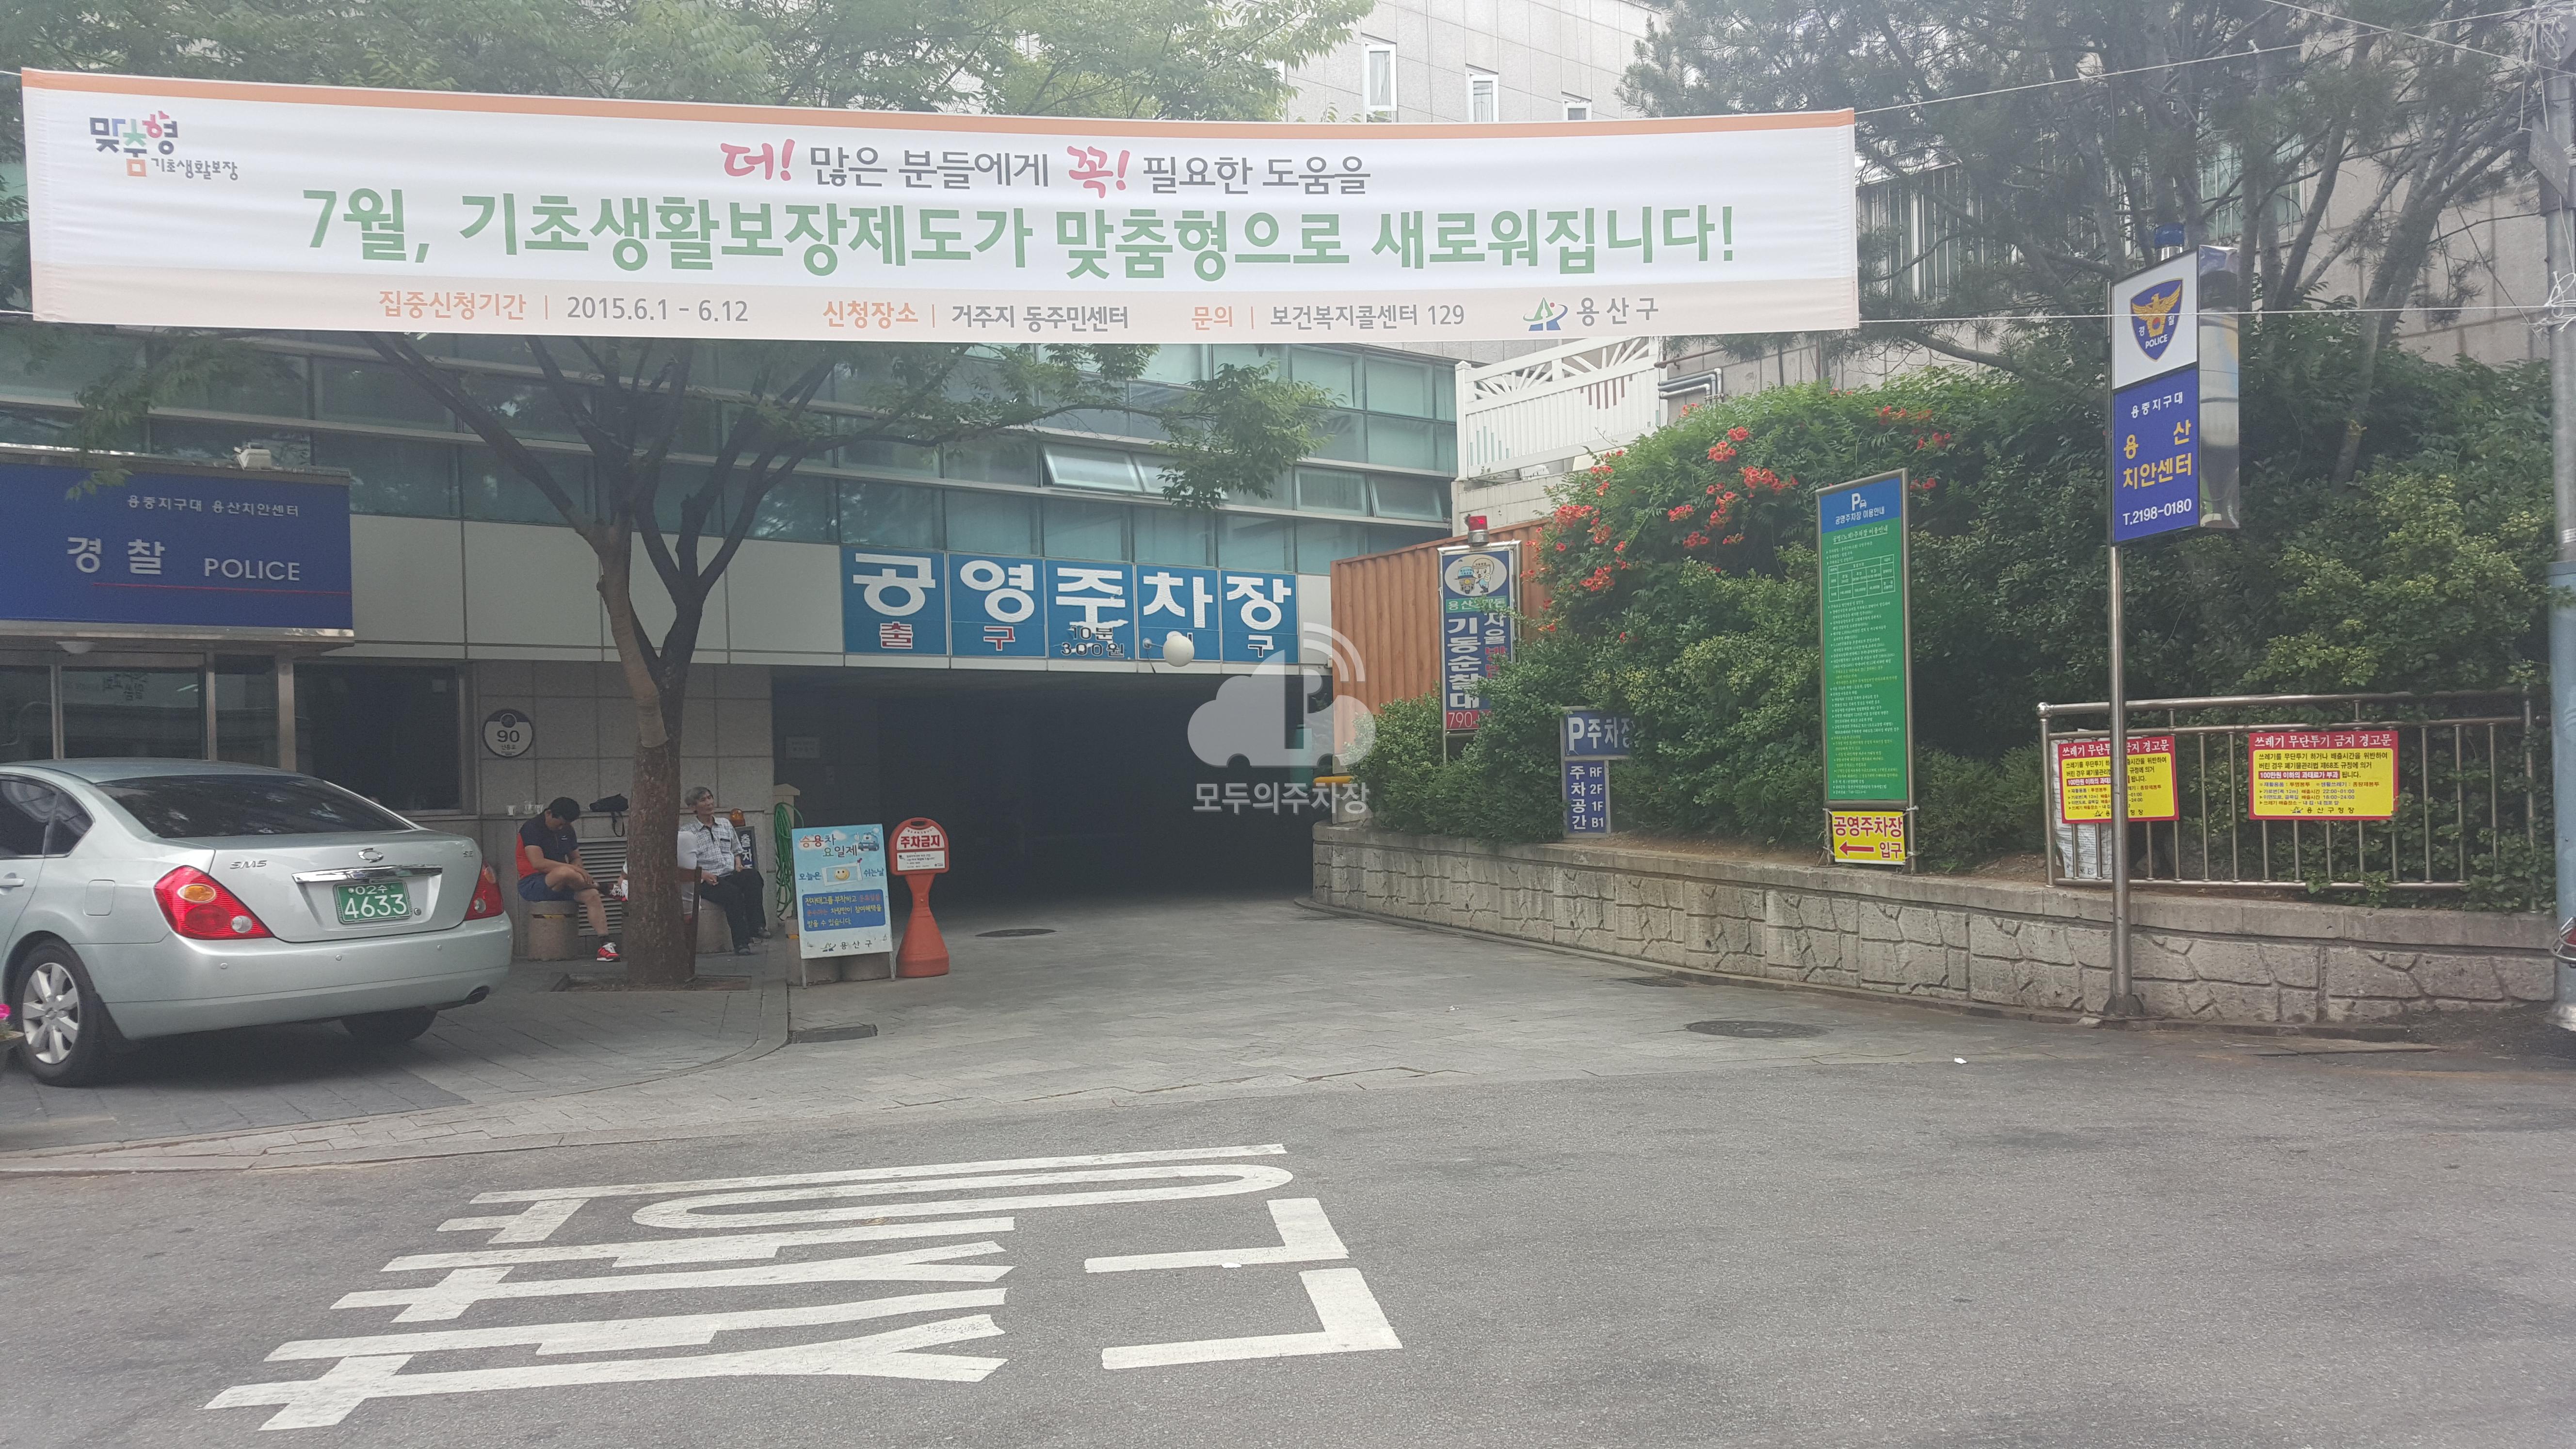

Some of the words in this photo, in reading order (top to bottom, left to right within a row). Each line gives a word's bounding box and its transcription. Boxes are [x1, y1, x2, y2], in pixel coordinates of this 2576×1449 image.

[89, 110, 178, 177] 맞춤형
[150, 158, 238, 181] 기초생활보장
[720, 138, 795, 181] 더!
[810, 146, 888, 187] 많은
[898, 150, 1049, 190] 분들에게
[1066, 145, 1130, 199] 꼭!
[1143, 156, 1253, 194] 필요한
[1262, 156, 1371, 195] 도움을
[303, 187, 431, 263] 7월,
[459, 193, 1033, 277] 기초생활보장제도가
[1056, 209, 1350, 282] 맞춤형으로
[1371, 204, 1734, 274] 새로워집니다!
[378, 290, 527, 321] 집중신청기간
[567, 296, 667, 322] 2015.6.1
[698, 300, 749, 322] 6.12
[823, 300, 919, 329] 신청장소
[952, 305, 1015, 328] 거주지
[1022, 306, 1129, 333] 동주민센터
[1191, 306, 1233, 331] 문의
[1270, 304, 1418, 331] 보건복지콜센터
[1428, 304, 1465, 326] 129
[2145, 334, 2168, 349] POLICE
[2131, 391, 2183, 419] 용중지구대
[2123, 452, 2192, 490] 치안센터
[128, 495, 202, 512] 용중지구대
[211, 500, 300, 517] 용산치안센터
[1851, 492, 1861, 511] P
[1835, 511, 1862, 525] 공영주차장
[1863, 506, 1885, 518] 이용안내
[2123, 498, 2192, 528] T.2198-0180
[204, 557, 301, 581] POLICE
[852, 552, 1291, 630] 공영주차장
[1069, 627, 1113, 641] 10분
[1061, 642, 1125, 658] 300원
[497, 730, 520, 742] 90
[2254, 735, 2284, 748] 쓰레기
[2288, 734, 2330, 748] 무단투기
[2334, 734, 2354, 747] 금지
[2359, 733, 2392, 747] 경고문
[2062, 744, 2085, 757] 쓰레기
[2142, 739, 2169, 753] 경고문
[1589, 767, 1602, 777] RF
[1590, 784, 1603, 794] 2F
[1592, 801, 1603, 811] 1F
[1591, 817, 1604, 828] B1
[1833, 816, 1903, 838] 공영주차장
[800, 834, 837, 848] 승용차
[901, 835, 940, 848] 주차금지
[822, 844, 857, 858] 요일제
[1879, 842, 1902, 860] 입구
[229, 860, 267, 870] SM5
[798, 871, 822, 881] 오늘은
[863, 867, 885, 877] 쉬는날
[344, 894, 408, 919] 4633
